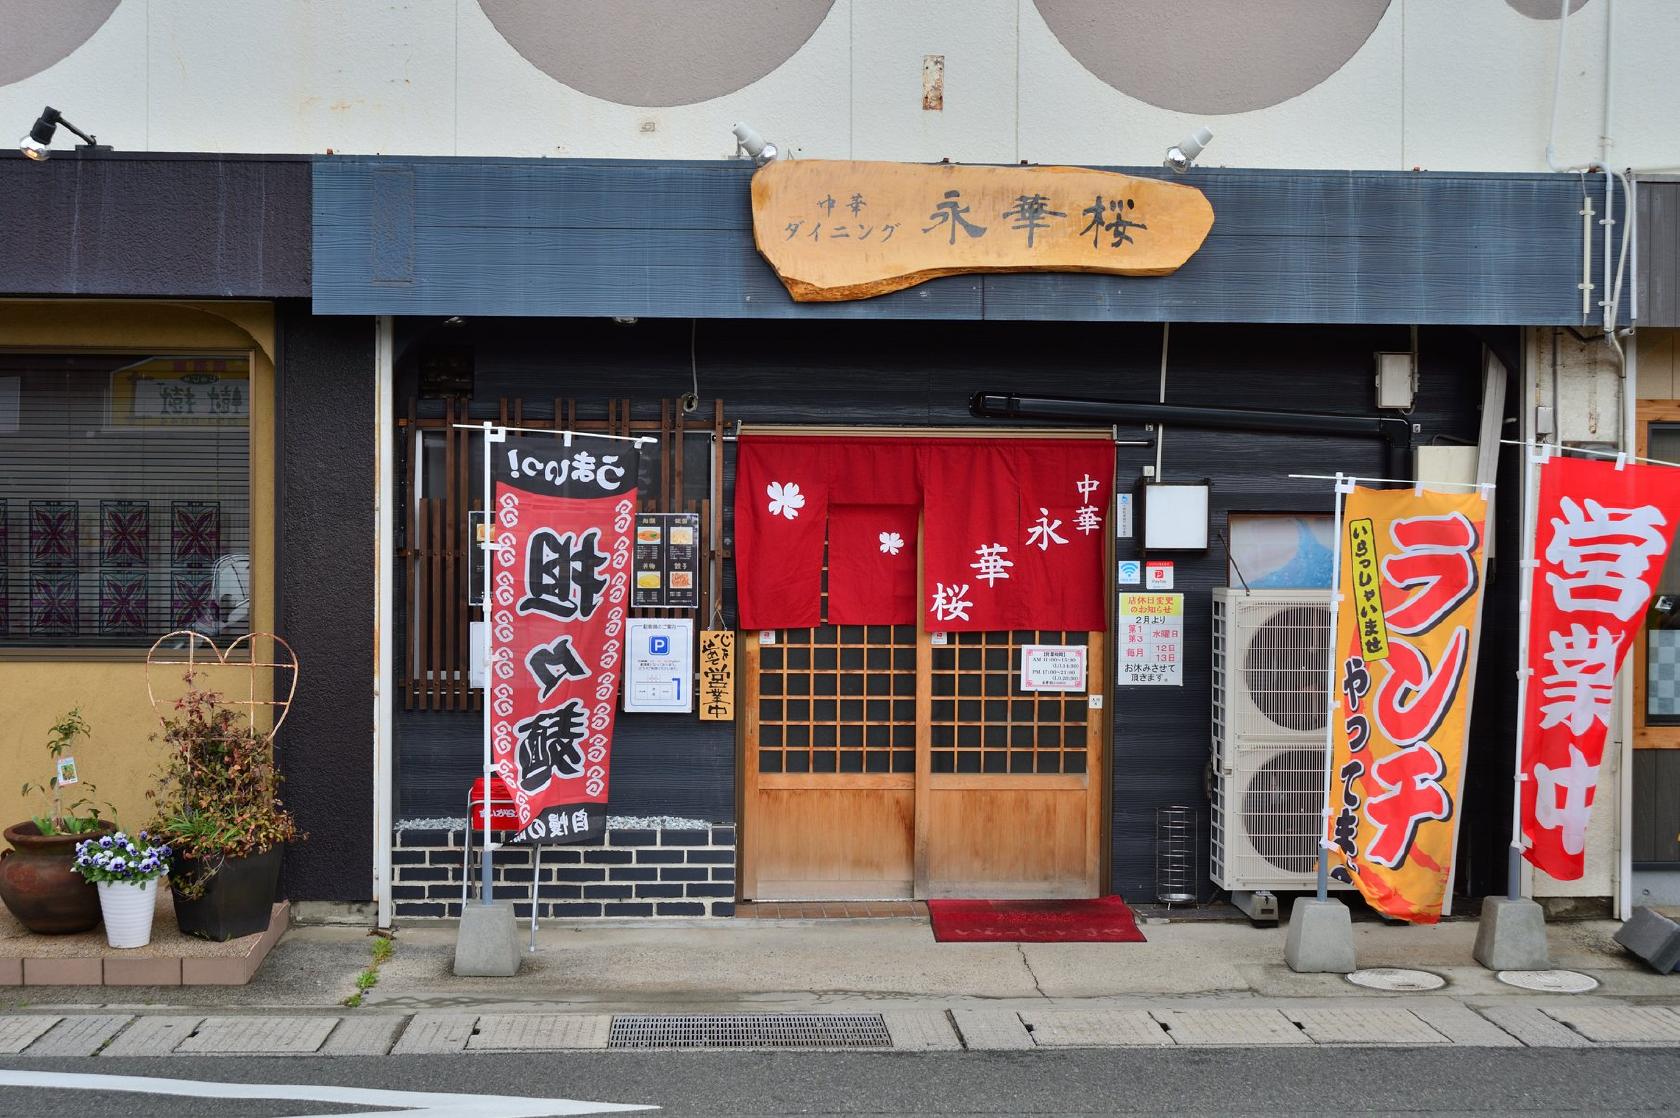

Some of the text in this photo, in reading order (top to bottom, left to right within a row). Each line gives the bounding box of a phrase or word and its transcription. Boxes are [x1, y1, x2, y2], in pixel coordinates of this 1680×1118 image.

[816, 193, 867, 220] 中華
[921, 190, 1148, 249] 永華桜
[784, 220, 901, 243] ダイニング
[1072, 473, 1102, 536] 中華
[930, 507, 1070, 622] 永華桜
[1352, 525, 1384, 655] いらっしゃいませ
[1128, 597, 1174, 605] 店休日変更
[1130, 606, 1172, 614] のお知らせ
[1135, 616, 1166, 624] 2月より
[1128, 625, 1142, 633] 第1
[1152, 630, 1178, 638] 水曜日
[1128, 635, 1143, 643] 第3
[1126, 648, 1144, 657] 毎月
[1156, 654, 1175, 662] 13日
[1124, 663, 1176, 673] お休みさせて
[1533, 496, 1668, 855] 営業中
[1131, 674, 1168, 682] 頂きます。
[702, 664, 731, 718] 営業中
[1363, 511, 1481, 870] ランチ
[1330, 656, 1372, 886] やってま
